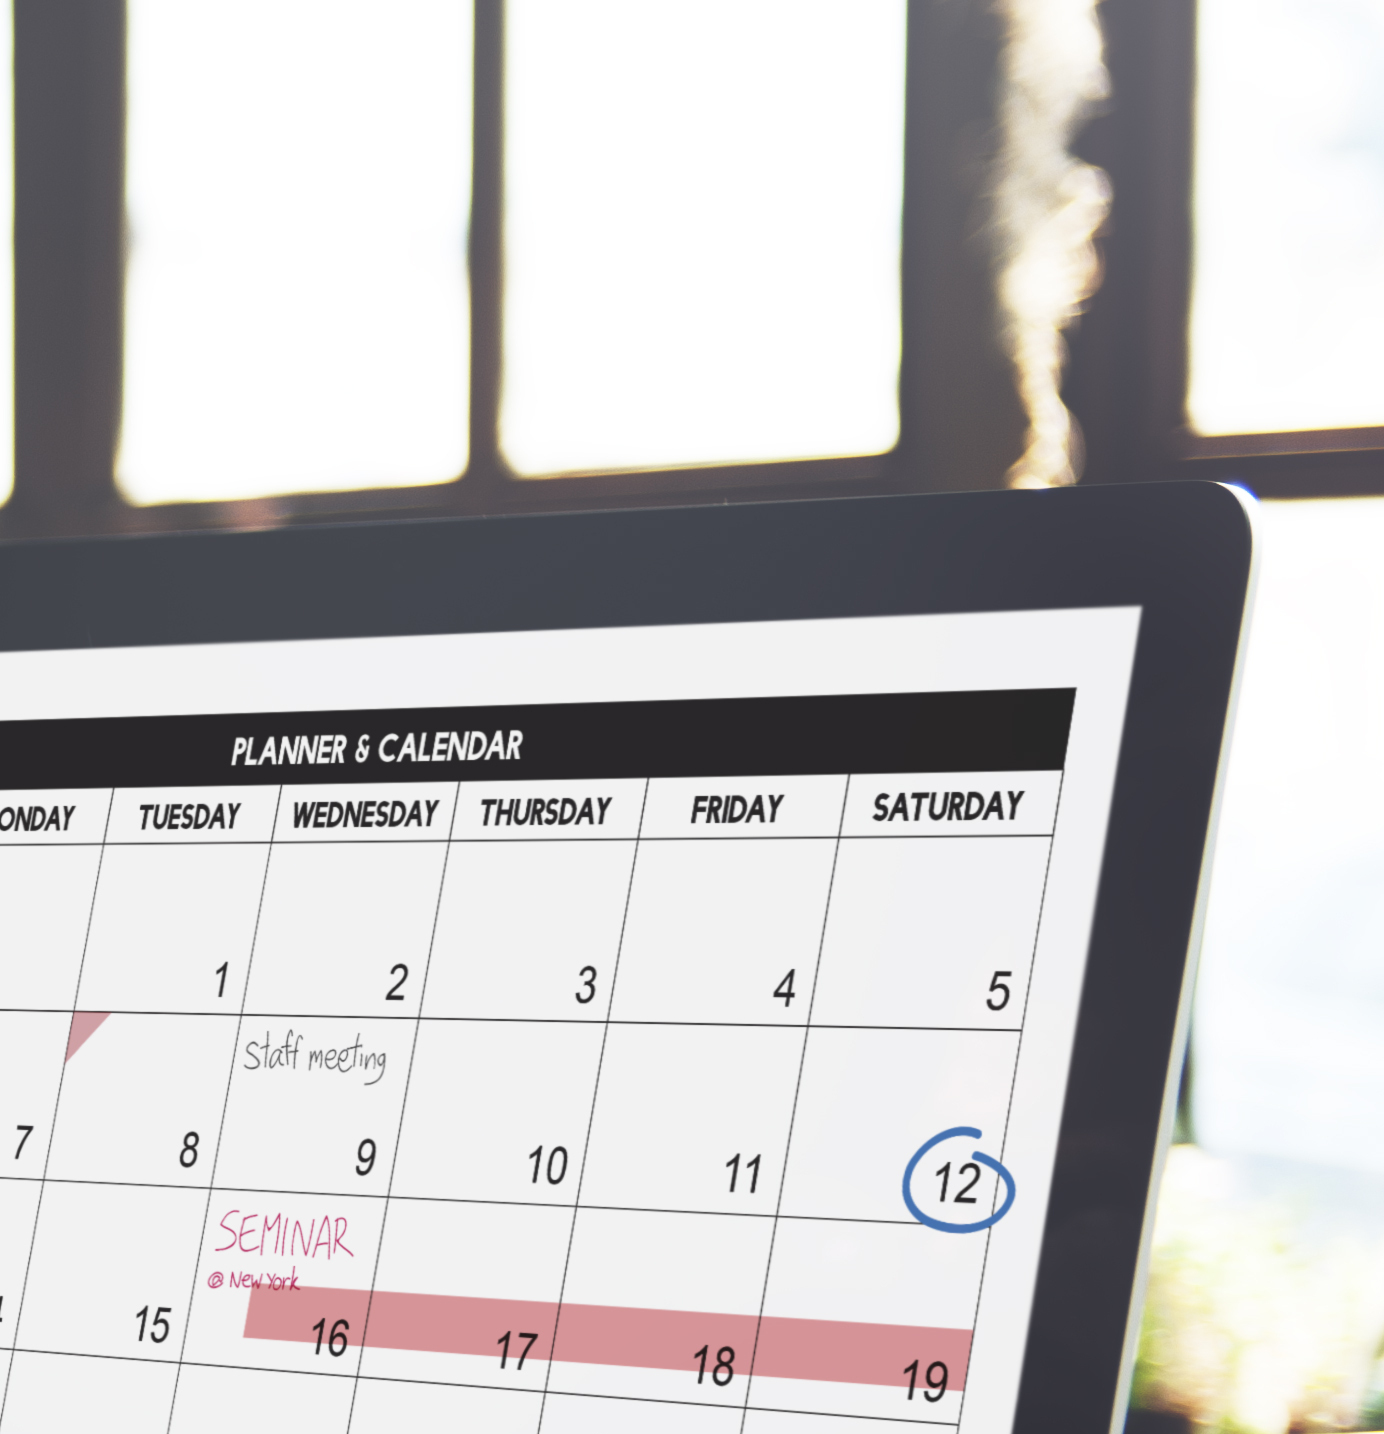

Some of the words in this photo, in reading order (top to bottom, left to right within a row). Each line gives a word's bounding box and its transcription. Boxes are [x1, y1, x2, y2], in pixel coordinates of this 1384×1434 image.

[231, 734, 348, 766] PLANNER
[354, 733, 370, 763] &
[378, 729, 524, 763] CALENDAR
[139, 802, 242, 830] TUESDAY
[293, 799, 440, 829] WEDNESDAY
[481, 797, 613, 826] THURSDAY
[690, 794, 785, 824] FRIDAY
[872, 790, 1025, 822] SATURDAY
[216, 961, 228, 998] 1
[385, 963, 409, 1001] 2
[575, 965, 597, 1004] 3
[773, 968, 795, 1008] 4
[986, 970, 1012, 1011] 5
[243, 1028, 304, 1070] Staff
[308, 1032, 387, 1086] meeting
[15, 1125, 34, 1160] 7
[179, 1131, 200, 1168] 8
[355, 1138, 376, 1176] 9
[529, 1145, 568, 1185] 10
[726, 1153, 761, 1194] 11
[934, 1162, 982, 1204] 12
[214, 1209, 354, 1260] SEMINAR
[207, 1271, 224, 1289] @
[136, 1305, 172, 1344] 15
[312, 1317, 350, 1357] 16
[497, 1330, 539, 1371] 17
[693, 1344, 736, 1387] 18
[903, 1359, 949, 1403] 19
